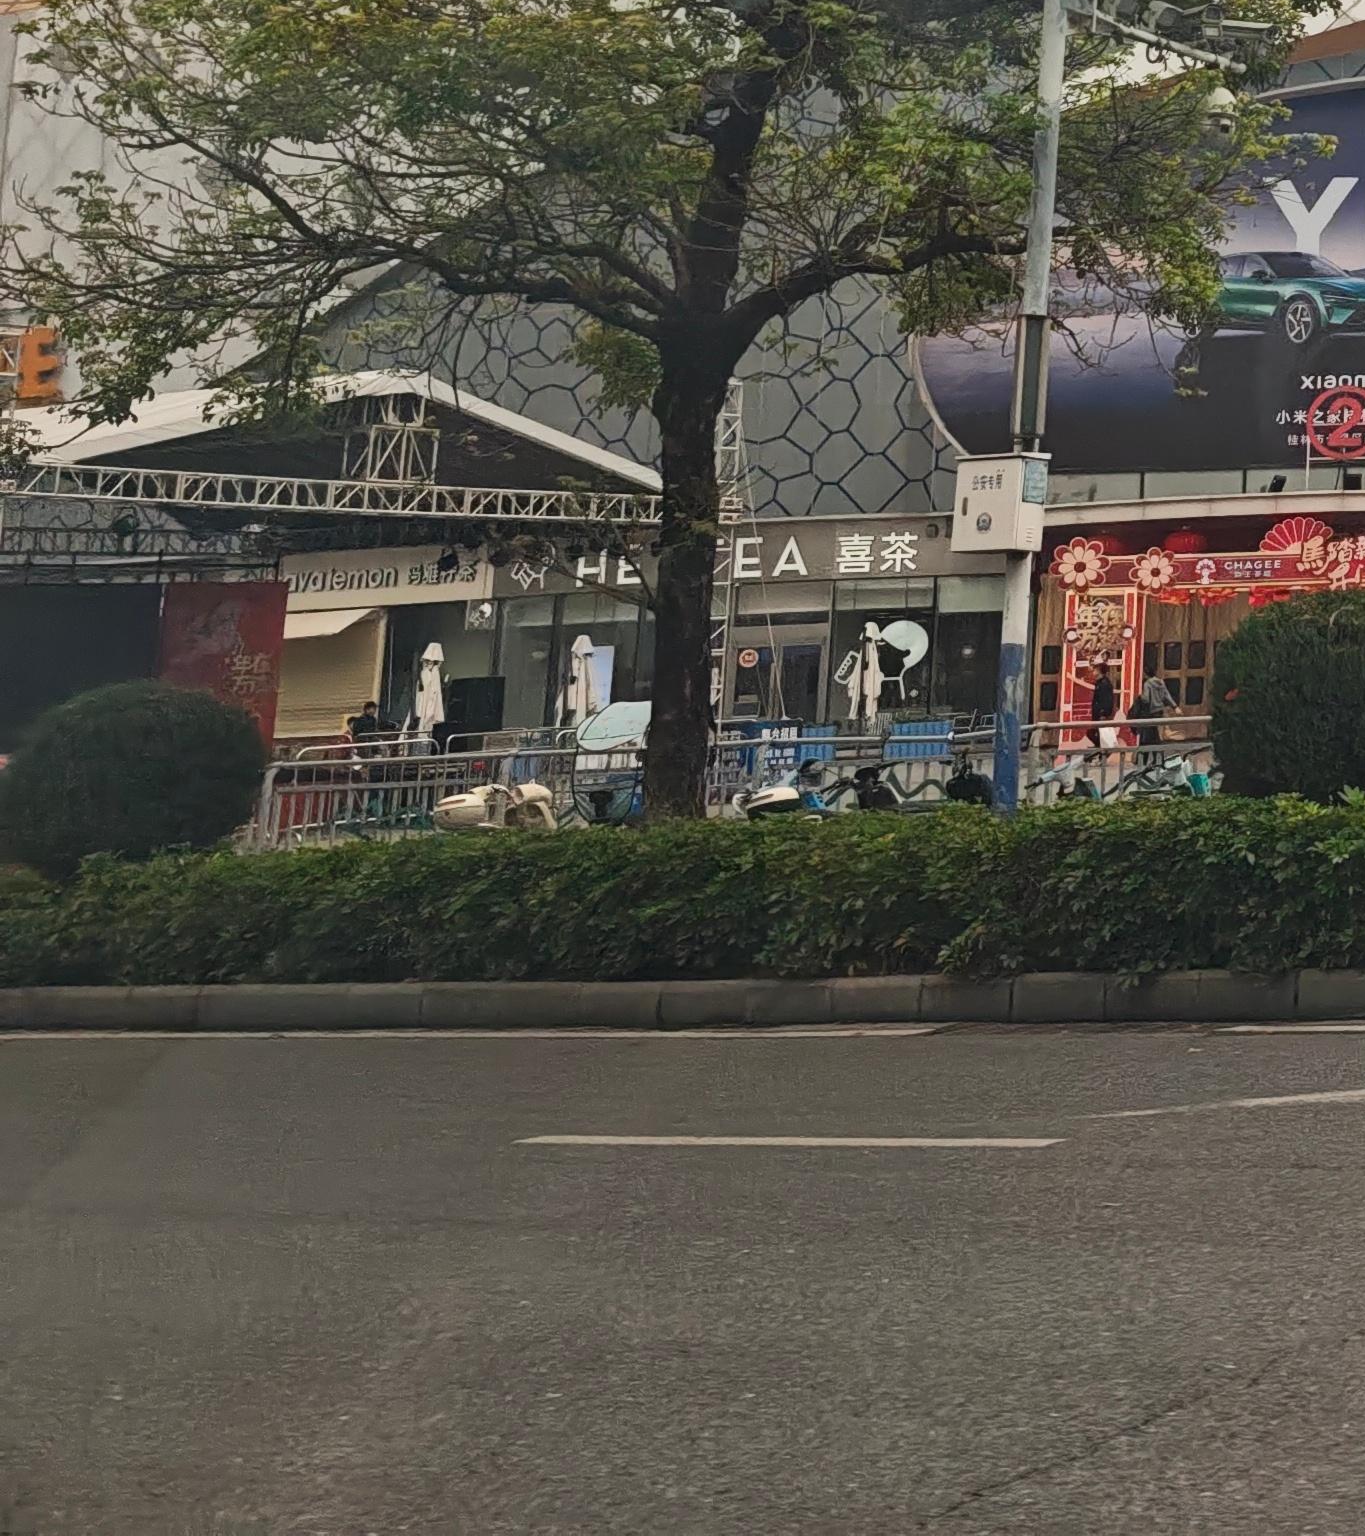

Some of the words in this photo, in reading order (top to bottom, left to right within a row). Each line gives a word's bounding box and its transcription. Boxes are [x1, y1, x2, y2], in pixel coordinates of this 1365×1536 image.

[575, 535, 809, 588] HEEA
[835, 531, 919, 574] 喜茶
[1224, 559, 1282, 570] CHAGEE
